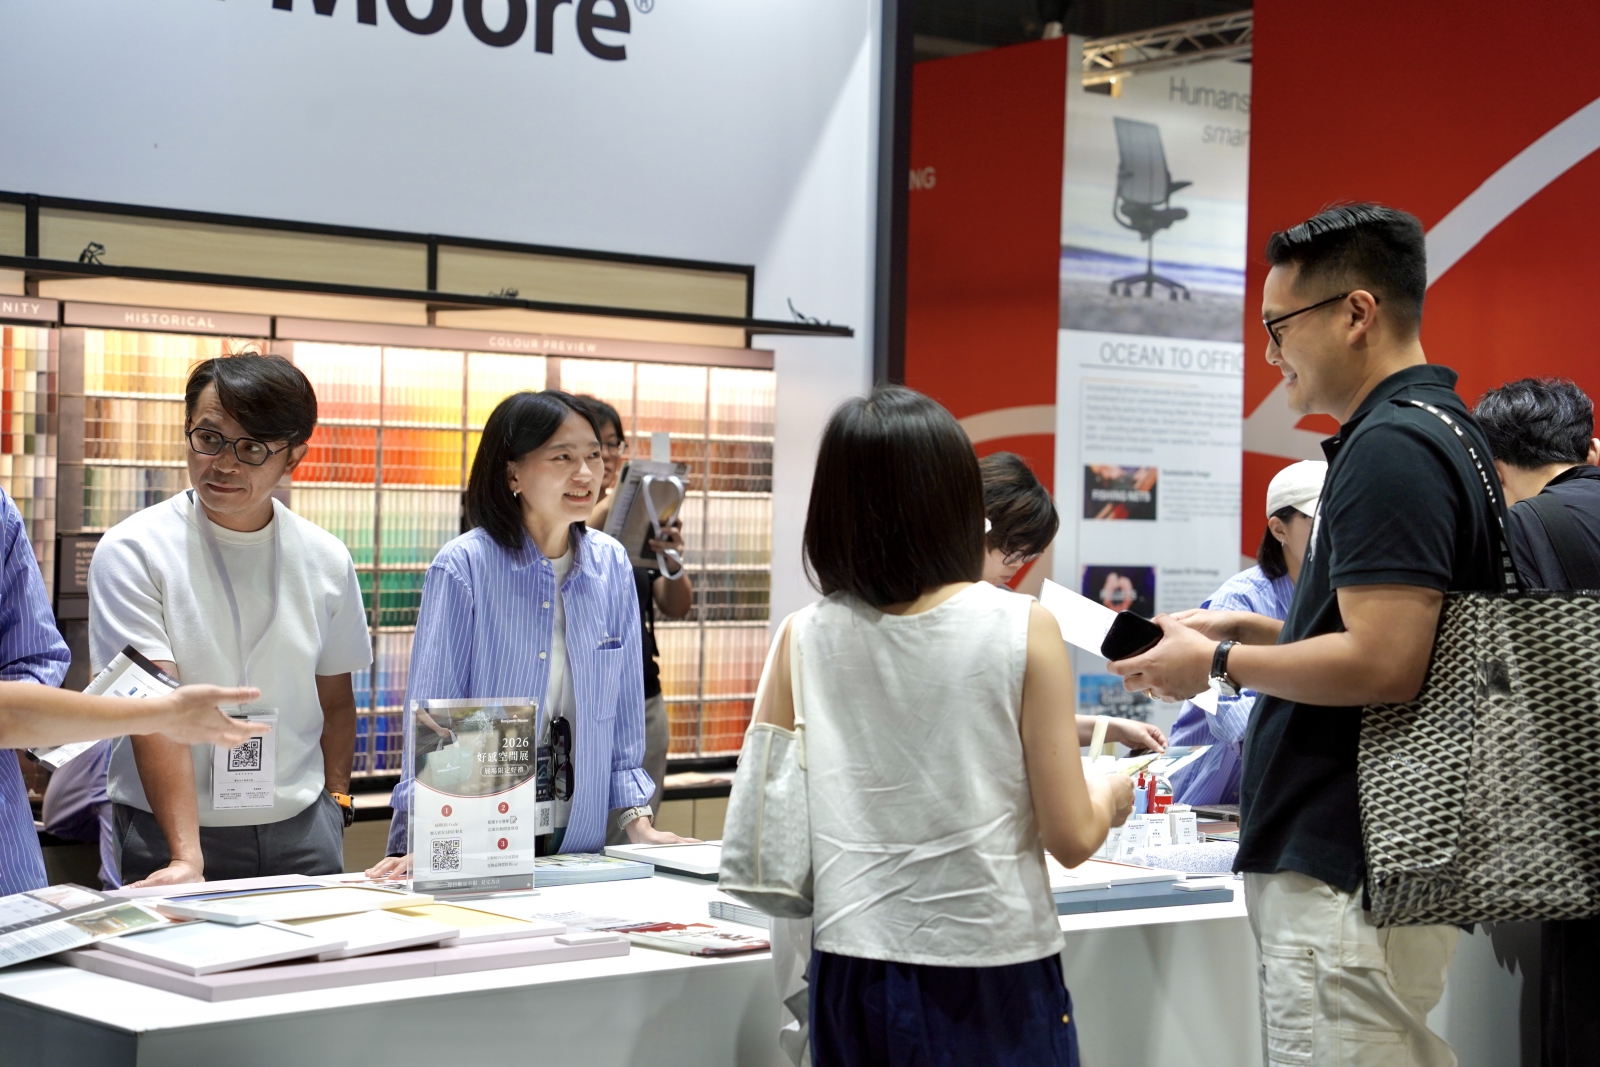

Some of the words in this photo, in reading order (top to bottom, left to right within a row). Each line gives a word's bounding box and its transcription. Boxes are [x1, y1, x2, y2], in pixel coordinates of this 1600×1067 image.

[1169, 76, 1250, 113] Humans
[124, 312, 215, 328] HISTORICAL
[488, 336, 539, 349] COLOUR
[543, 340, 597, 353] PREVIEW
[1099, 341, 1165, 367] OCEAN
[1169, 346, 1193, 369] TO
[502, 737, 529, 748] 2026
[477, 750, 529, 763] 好感空間展
